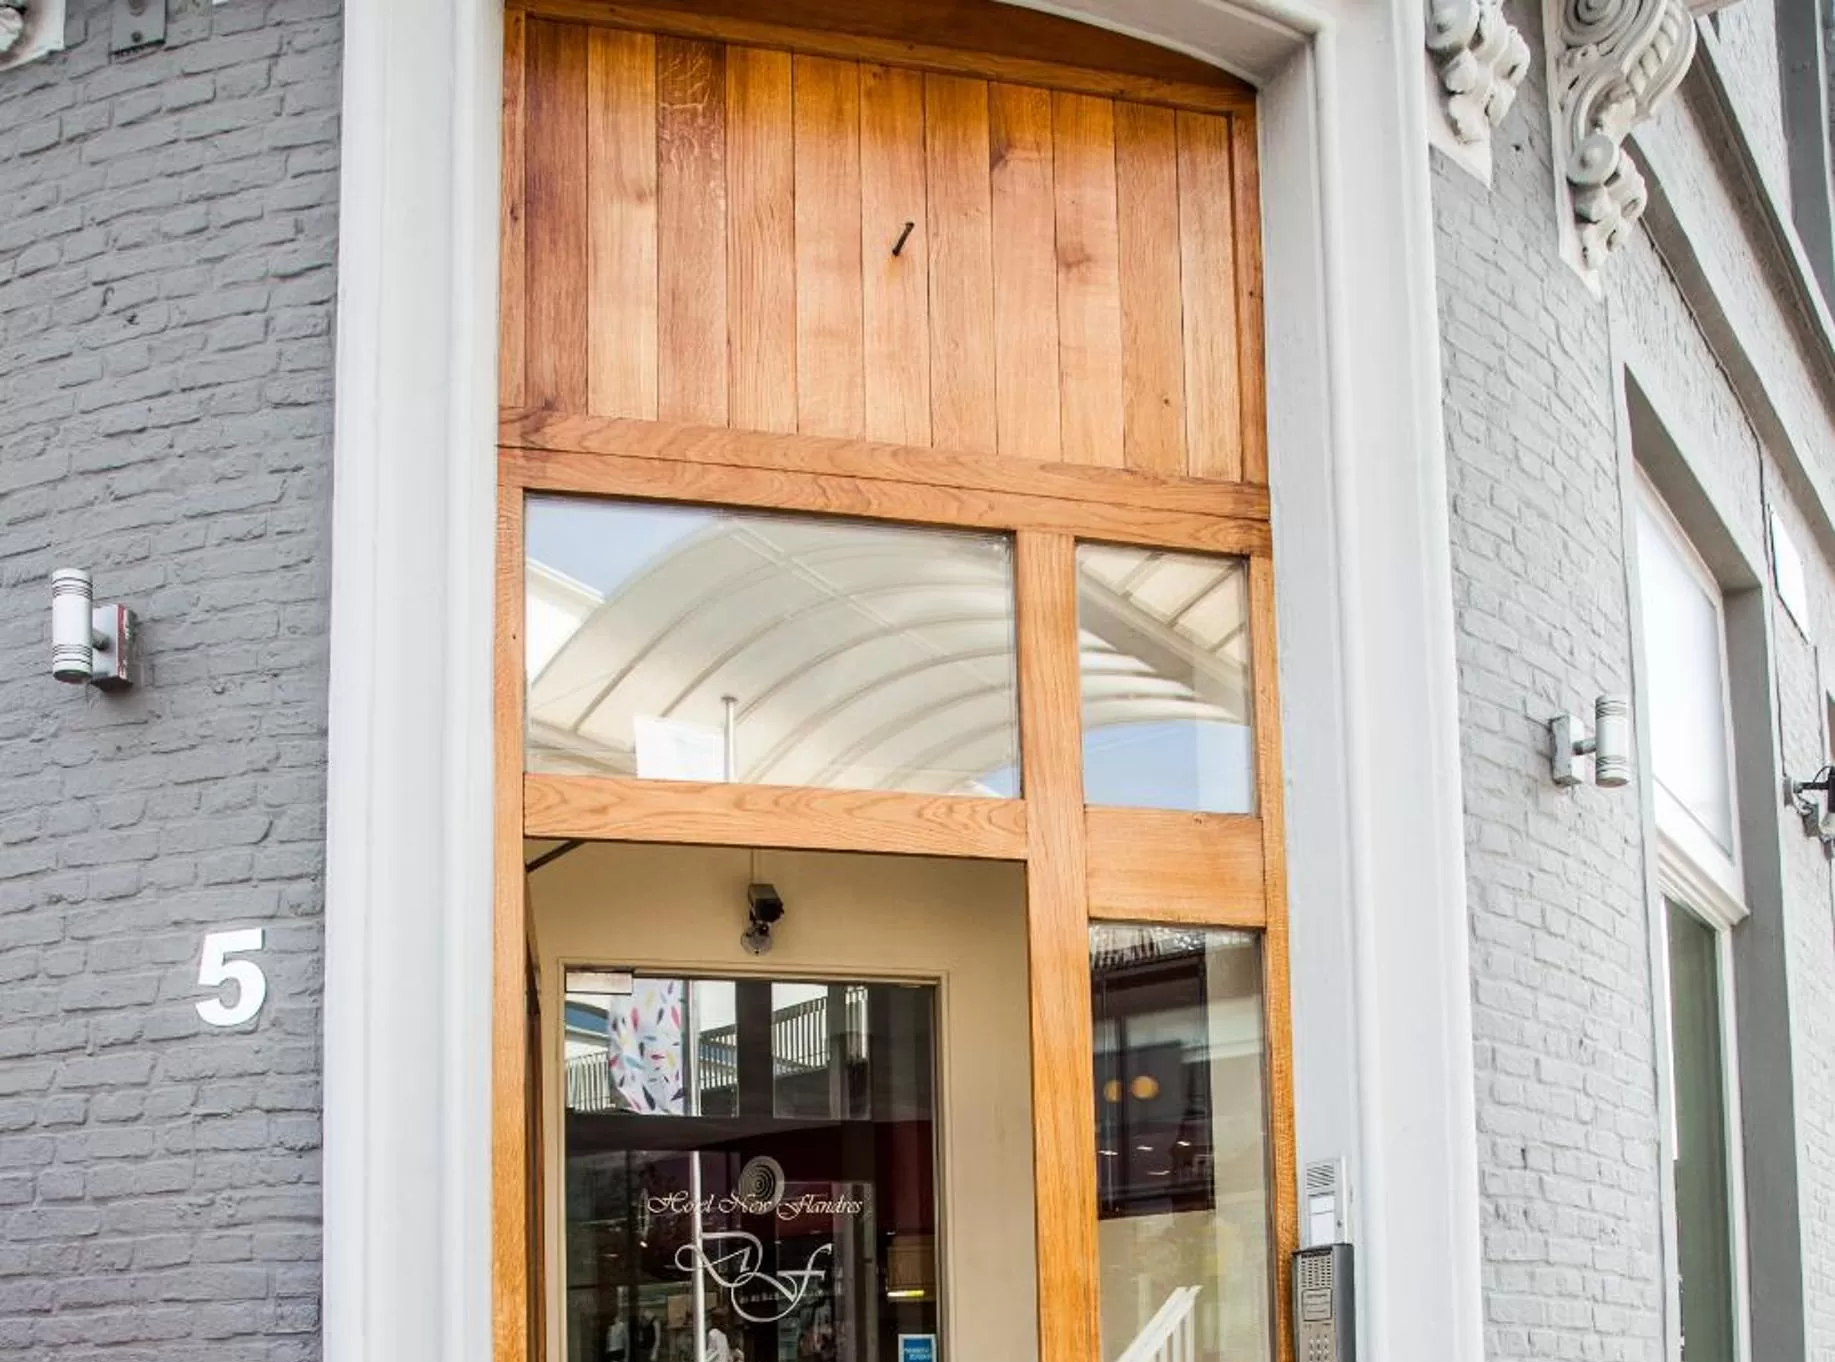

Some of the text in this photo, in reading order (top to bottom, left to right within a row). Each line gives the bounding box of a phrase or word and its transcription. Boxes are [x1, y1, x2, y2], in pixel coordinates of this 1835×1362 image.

[195, 928, 266, 1026] 5
[718, 1188, 773, 1214] New
[776, 1193, 863, 1221] Flandres
